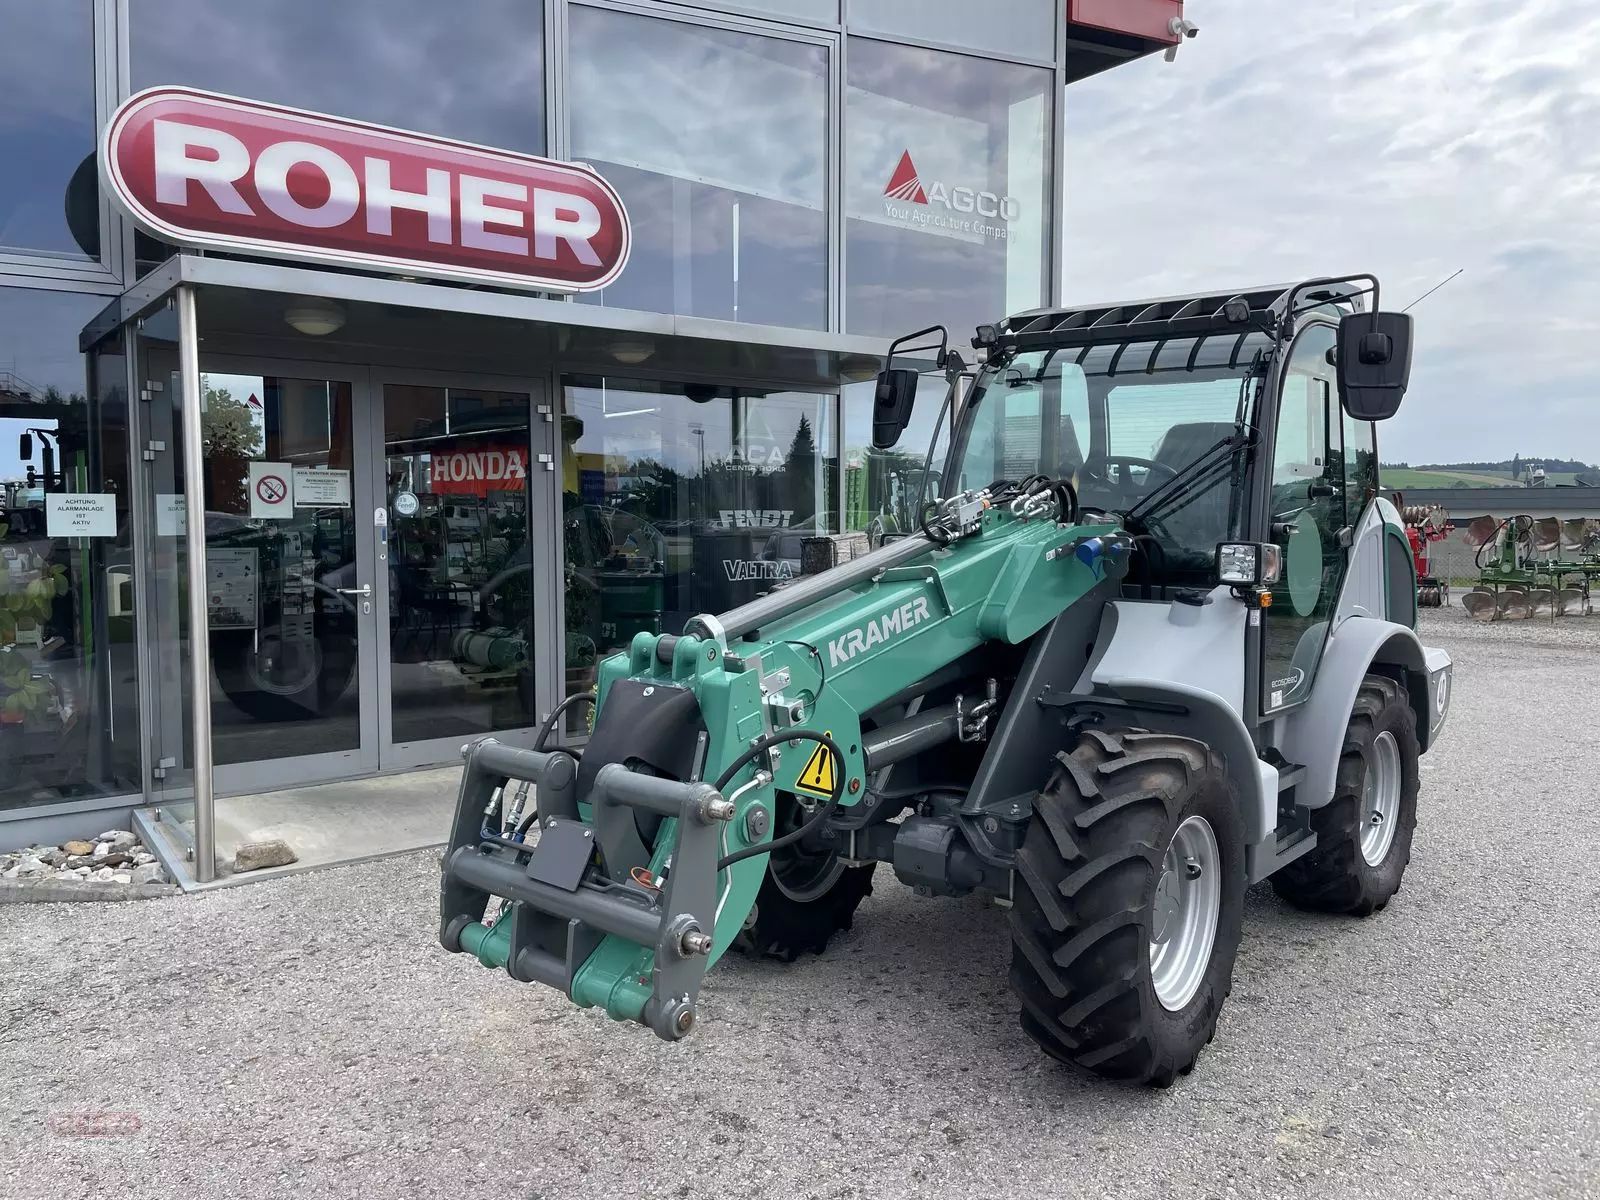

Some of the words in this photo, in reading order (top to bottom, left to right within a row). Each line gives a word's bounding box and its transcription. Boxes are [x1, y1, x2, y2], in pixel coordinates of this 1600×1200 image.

[153, 118, 604, 267] ROHER
[927, 180, 1021, 222] AGCO
[885, 203, 909, 219] Your
[911, 209, 970, 231] Agriculture
[973, 221, 1018, 244] Company
[432, 451, 526, 481] HONDA
[397, 501, 415, 510] Fendt
[719, 510, 794, 528] FENDT
[723, 559, 793, 581] VALTRA
[828, 597, 931, 668] KRAMER
[1271, 675, 1298, 688] ecospeed
